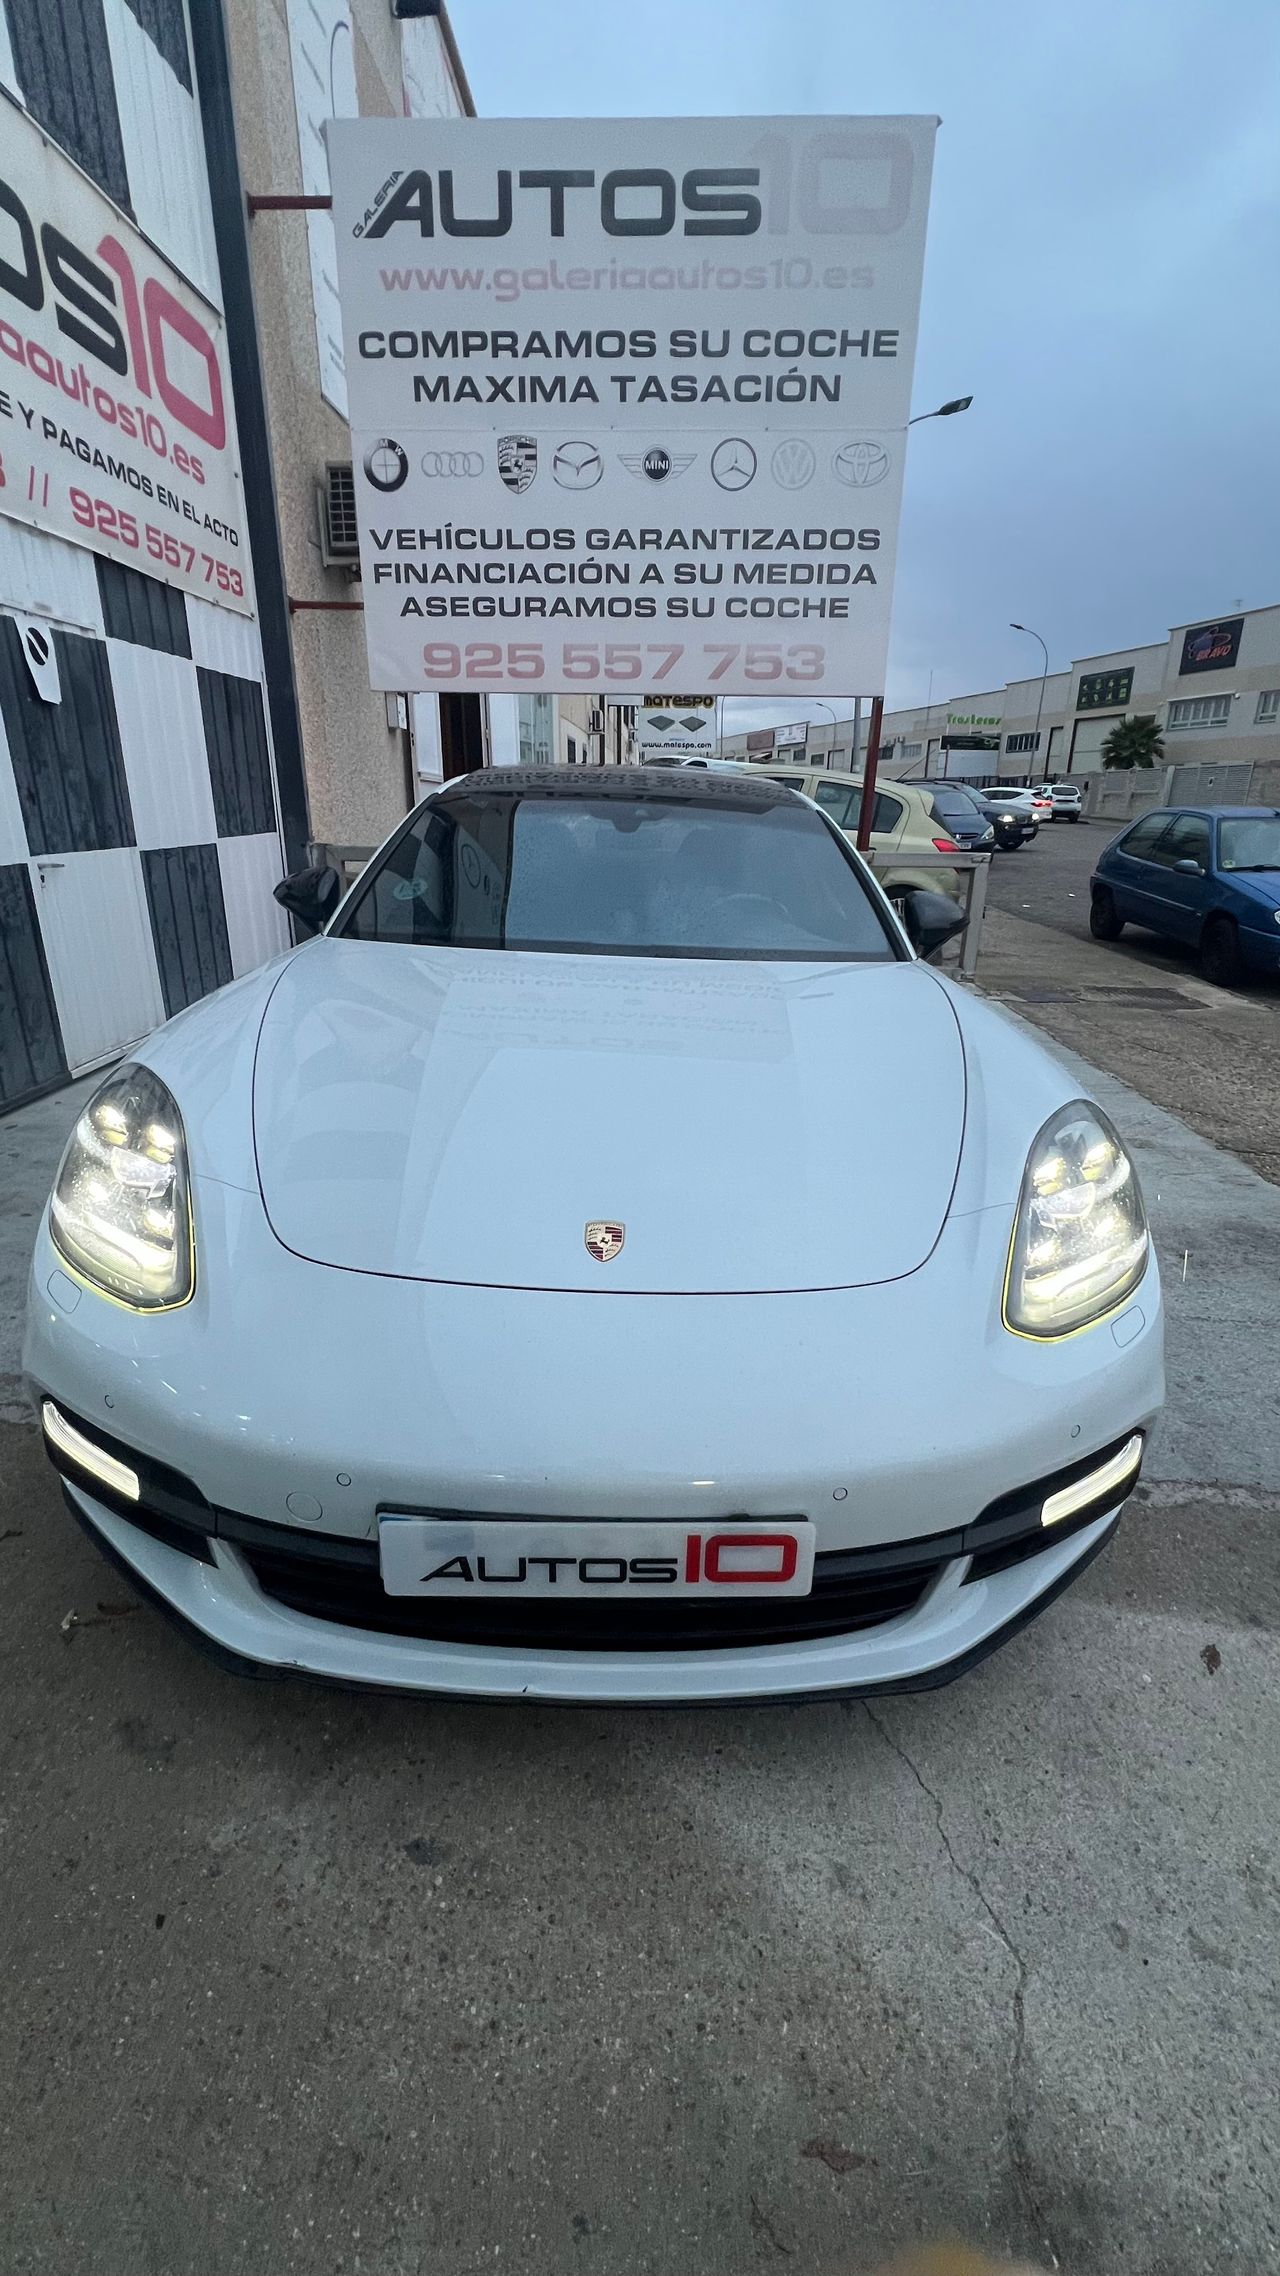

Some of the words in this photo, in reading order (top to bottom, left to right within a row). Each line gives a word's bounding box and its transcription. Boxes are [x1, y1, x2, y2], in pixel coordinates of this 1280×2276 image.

[352, 170, 404, 238] GALERIA
[379, 258, 875, 303] www.galeriaautos10.es
[358, 330, 657, 359] COMPRAMOS
[668, 330, 731, 358] SU
[742, 329, 900, 358] COCHE
[413, 375, 600, 403] MAXIMA
[610, 367, 842, 403] TASACIÓN
[18, 401, 34, 429] Y
[41, 415, 154, 498] PAGAMOS
[157, 484, 180, 513] EN
[183, 500, 201, 525] EL
[203, 514, 239, 547] ACTO
[645, 460, 669, 470] MINI
[69, 486, 140, 549] 925
[145, 523, 196, 573] 557
[201, 552, 244, 597] 753
[369, 522, 576, 551] VEHÍCULOS
[585, 528, 881, 551] GARANTIZADOS
[374, 557, 630, 585] FINANCIACIÓN
[639, 563, 666, 585] A
[673, 563, 724, 585] SU
[733, 563, 878, 585] MEDIDA
[400, 597, 657, 619] ASEGURAMOS
[666, 597, 716, 618] SU
[724, 597, 850, 619] COCHE
[422, 642, 545, 680] 925
[562, 643, 685, 681] 557
[702, 643, 826, 682] 753
[642, 742, 712, 750] www.matespo.com
[420, 1534, 798, 1584] AUTOS10
